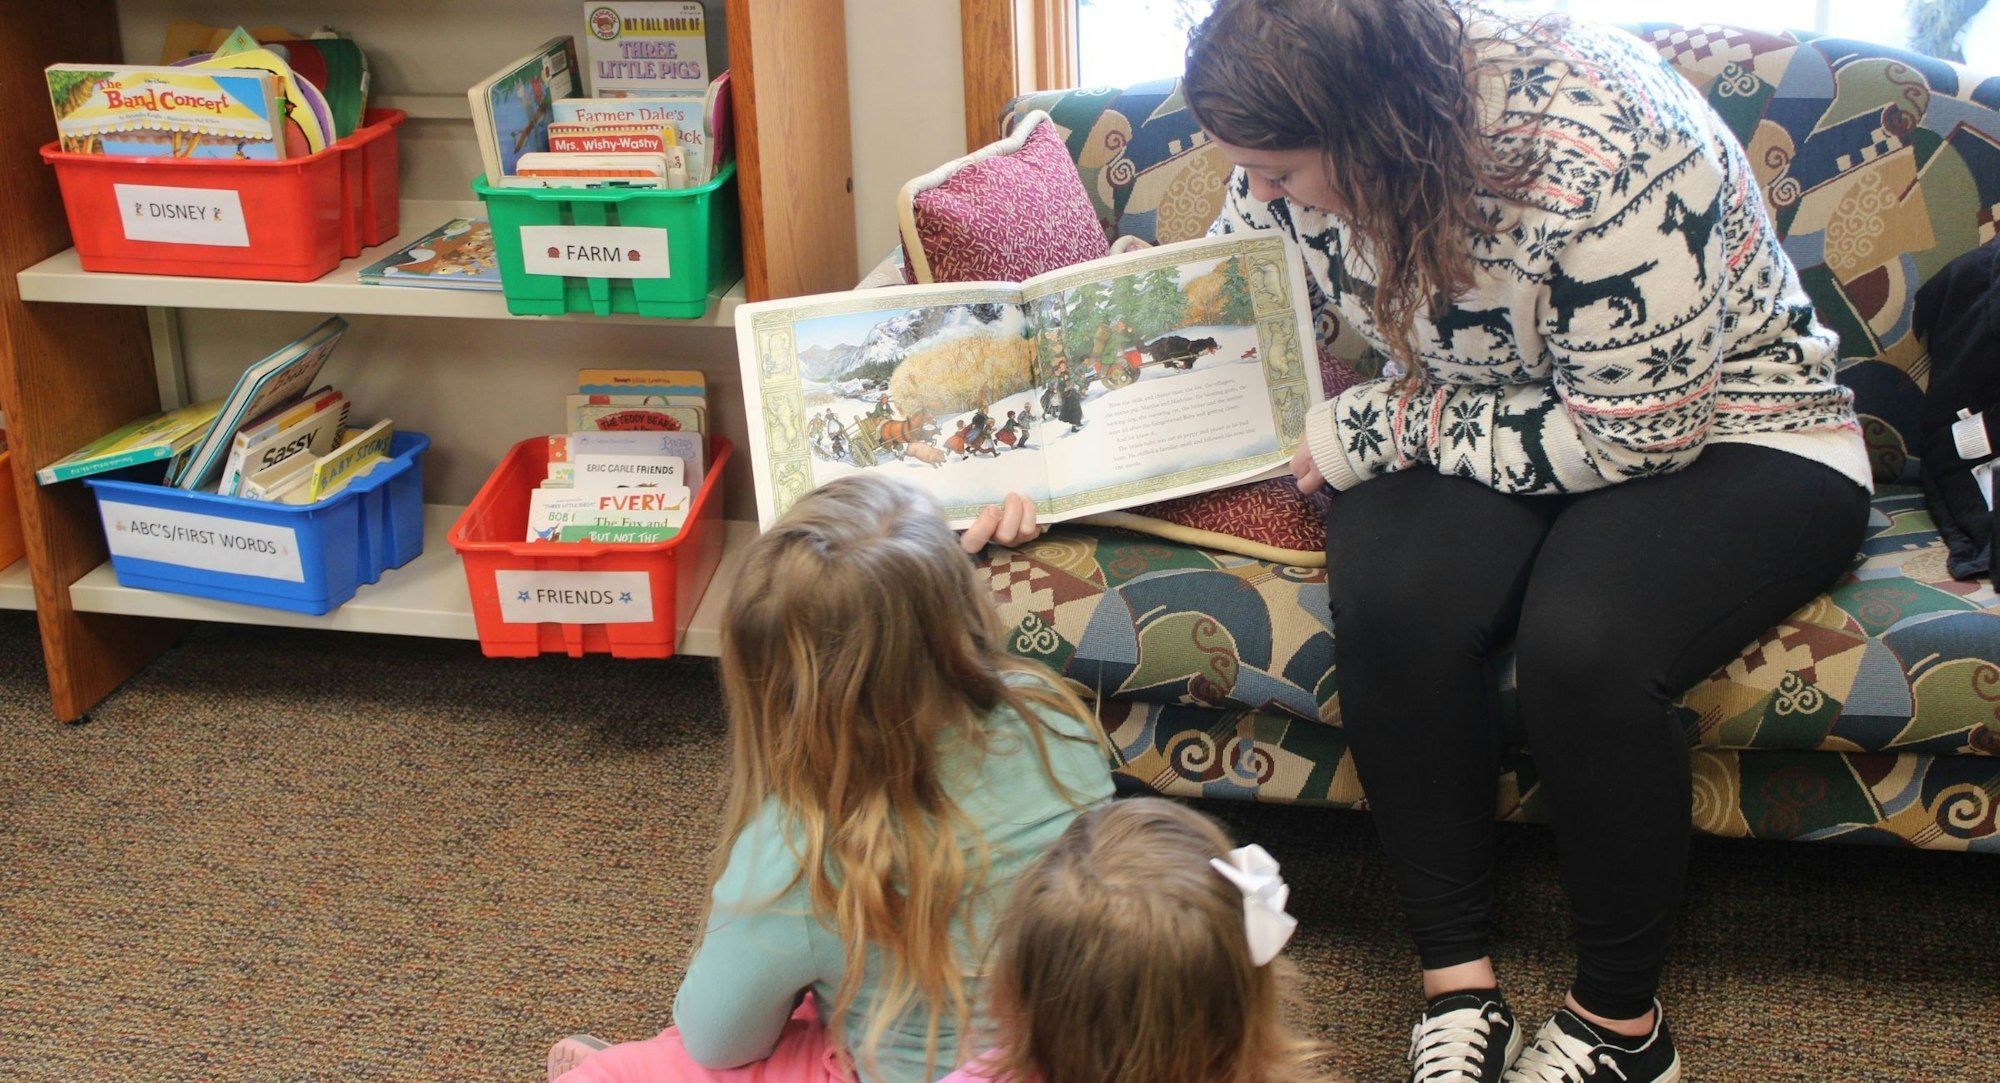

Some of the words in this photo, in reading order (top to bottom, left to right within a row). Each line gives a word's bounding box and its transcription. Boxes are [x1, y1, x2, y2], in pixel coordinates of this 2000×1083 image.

[624, 17, 637, 31] MY
[640, 17, 662, 31] TALL
[663, 17, 688, 31] BOOK
[689, 17, 701, 30] OF
[618, 40, 678, 59] THREE
[597, 61, 656, 79] LITTLE
[658, 61, 701, 79] PIGS
[97, 80, 122, 90] The
[102, 88, 159, 111] Band
[160, 91, 229, 113] Concert
[576, 108, 634, 122] Farmer
[639, 107, 685, 121] Dale's
[555, 140, 579, 151] Mrs.
[583, 138, 659, 151] Wishy-Washy
[149, 203, 206, 220] DISNEY
[566, 245, 621, 262] FARM
[601, 417, 619, 429] THE
[619, 413, 645, 424] TEDDY
[260, 428, 322, 472] Sassy
[320, 460, 352, 490] BABY
[355, 437, 390, 463] SIGNS
[587, 464, 606, 472] ERIC
[608, 464, 634, 473] CARLE
[637, 465, 674, 475] FRIENDS
[548, 511, 568, 521] BOB
[594, 516, 617, 526] The
[621, 517, 642, 527] Fox
[644, 518, 668, 528] and
[131, 520, 215, 546] ABC'S/FIRST
[218, 532, 277, 555] WORDS
[588, 530, 610, 542] BUT
[613, 531, 637, 543] NOT
[537, 589, 614, 604] FRIENDS
